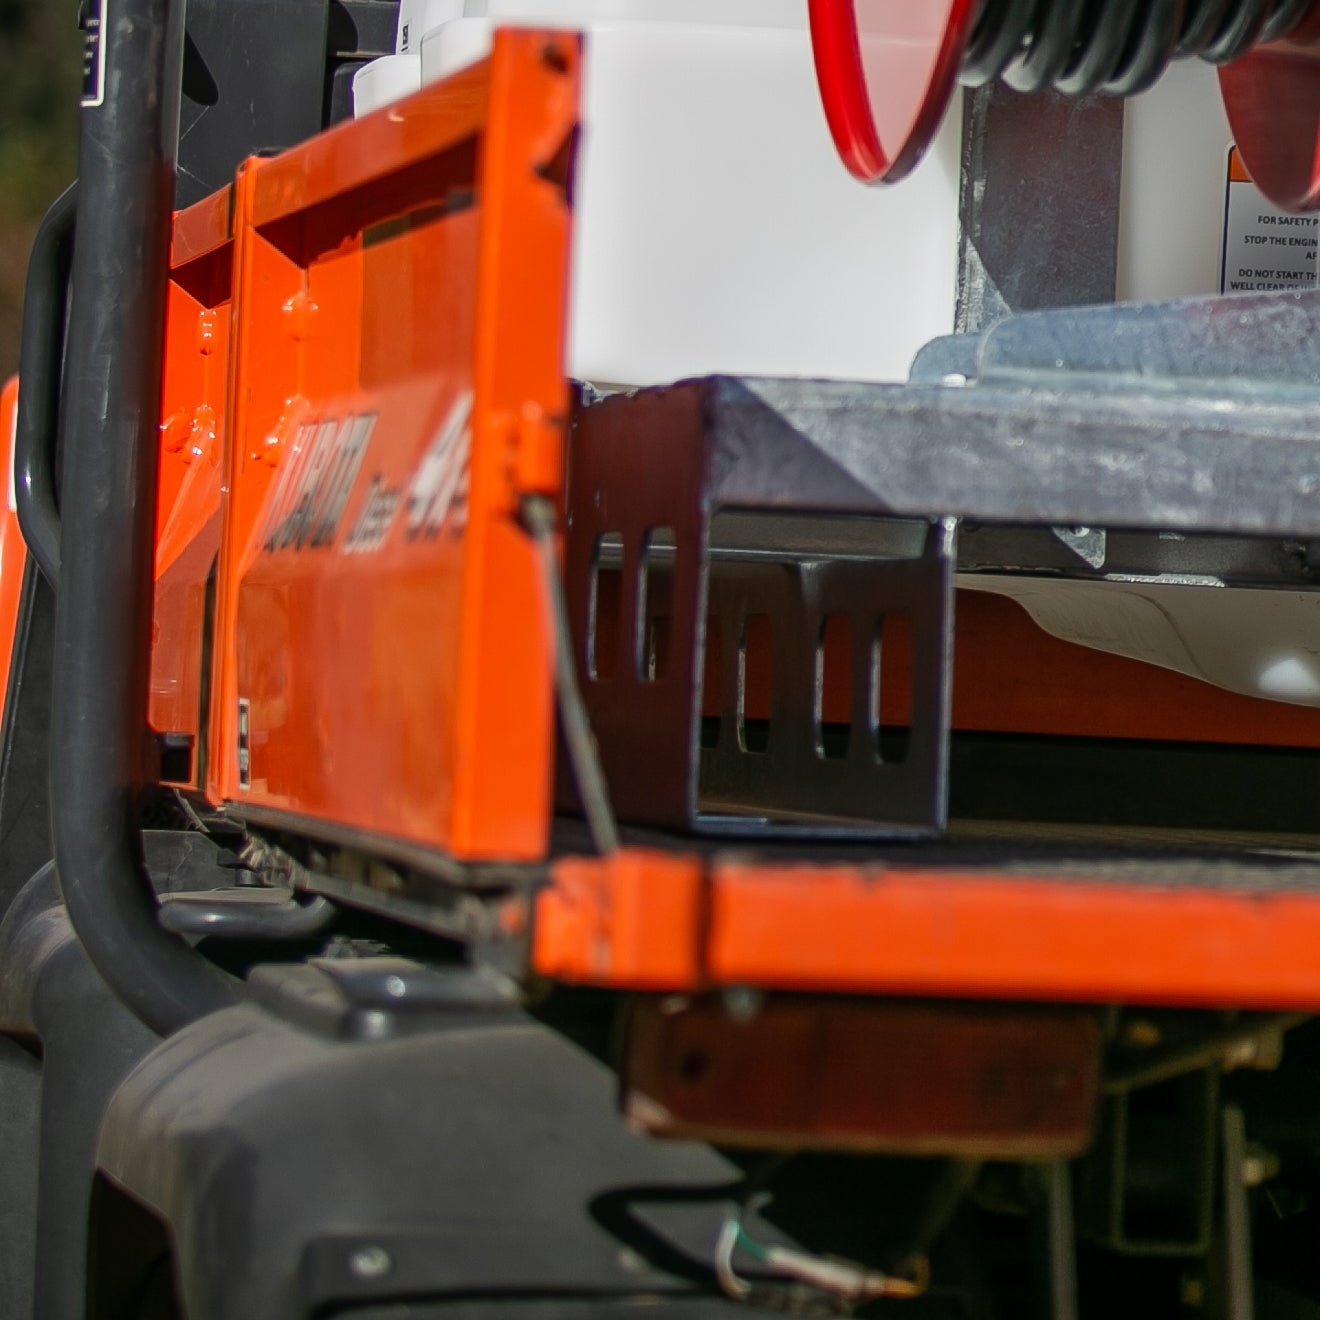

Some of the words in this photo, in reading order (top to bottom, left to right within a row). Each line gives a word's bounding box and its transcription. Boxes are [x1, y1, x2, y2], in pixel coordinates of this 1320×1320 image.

[1258, 215, 1276, 225] FOR
[1278, 216, 1311, 226] SAFETY
[1244, 235, 1268, 245] STOP
[1269, 236, 1287, 246] THE
[1289, 237, 1318, 247] ENGIN
[1238, 268, 1253, 278] DO
[1254, 269, 1274, 278] NOT
[1276, 270, 1303, 279] START
[1230, 281, 1255, 291] WELL
[1256, 282, 1284, 291] CLEAR
